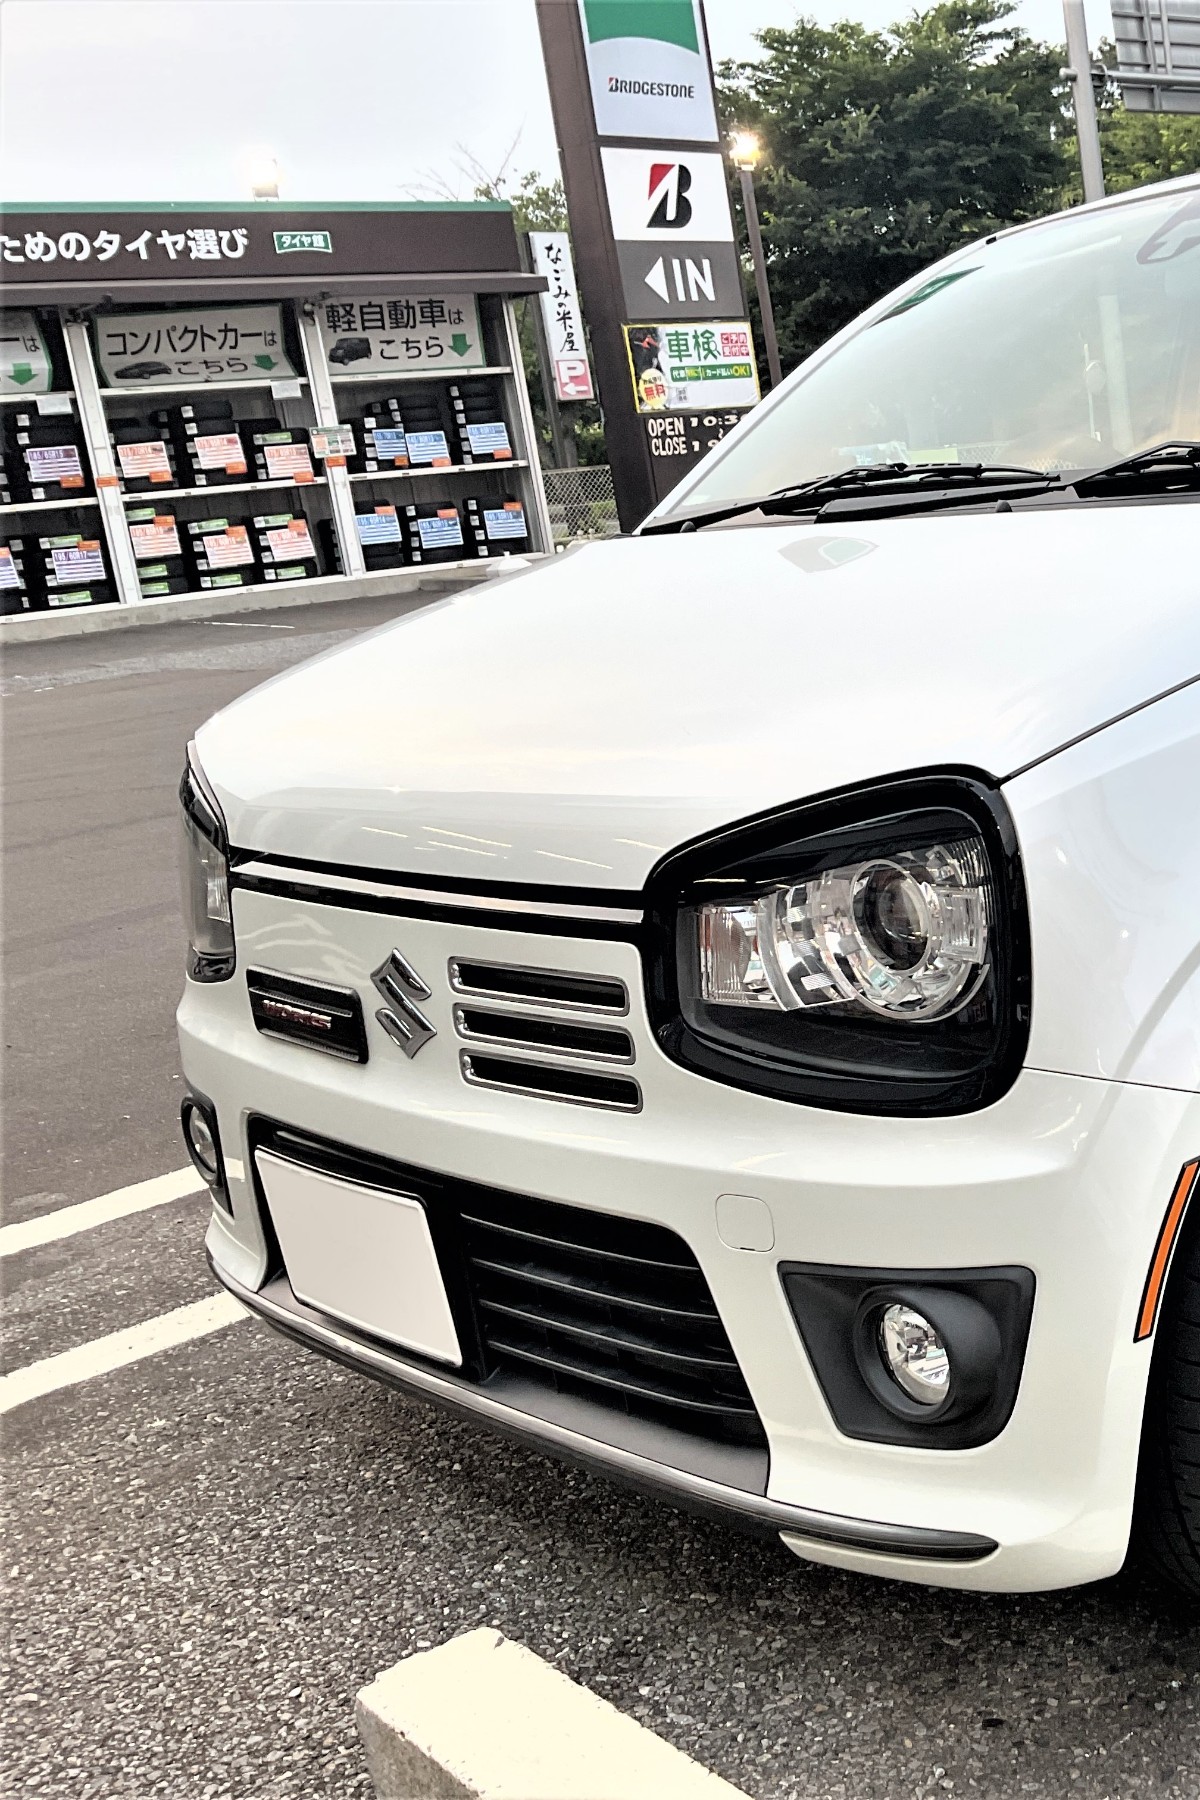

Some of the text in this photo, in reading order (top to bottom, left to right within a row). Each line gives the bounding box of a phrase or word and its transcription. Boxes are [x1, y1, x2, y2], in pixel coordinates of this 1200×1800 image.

[608, 77, 694, 98] BRIDGESTONE
[672, 257, 716, 302] IN
[544, 243, 580, 353] なごみの米屋
[325, 298, 464, 333] 軽自動車は
[106, 323, 277, 356] コンパクトカーは
[379, 336, 444, 360] こちら
[665, 329, 720, 362] 車検
[174, 357, 249, 375] こちら
[559, 361, 585, 384] P
[648, 417, 684, 437] OPEN
[651, 437, 687, 456] CLOSE
